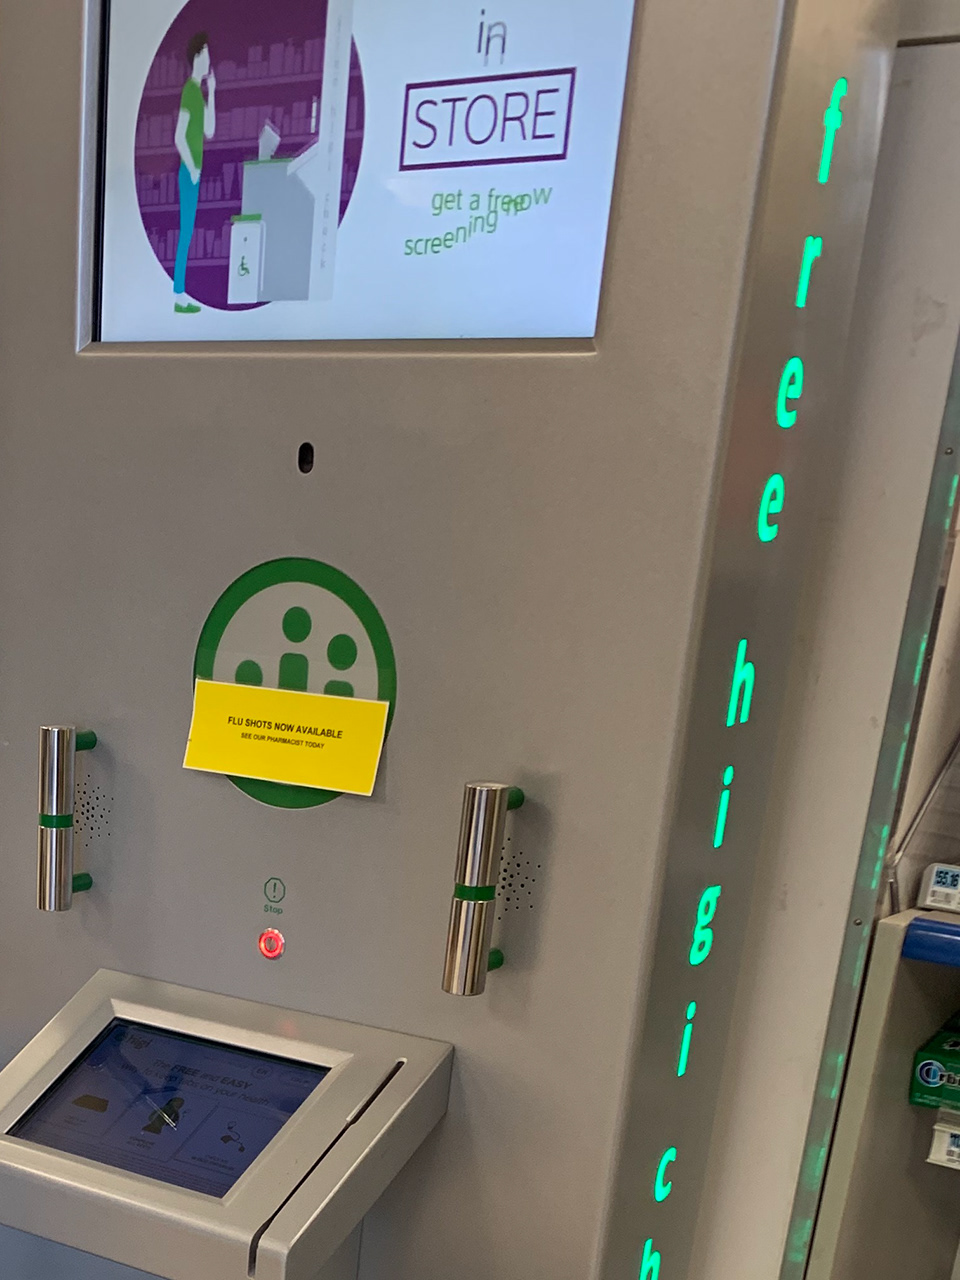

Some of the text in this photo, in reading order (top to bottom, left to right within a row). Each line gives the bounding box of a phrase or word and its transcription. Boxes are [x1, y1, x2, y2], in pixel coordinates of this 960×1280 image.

[477, 8, 507, 66] in
[412, 88, 560, 149] STORE
[431, 188, 463, 216] get
[469, 192, 480, 211] a
[404, 209, 498, 256] screening
[757, 77, 848, 543] free
[227, 716, 343, 739] FLU SHOTS NOW AVAILABLE
[241, 732, 325, 749] SEE OUR PHARMACIST TODAY
[677, 638, 756, 1077] higi
[263, 904, 284, 916] Stop
[171, 1064, 200, 1077] FREE
[220, 1076, 253, 1090] EASY
